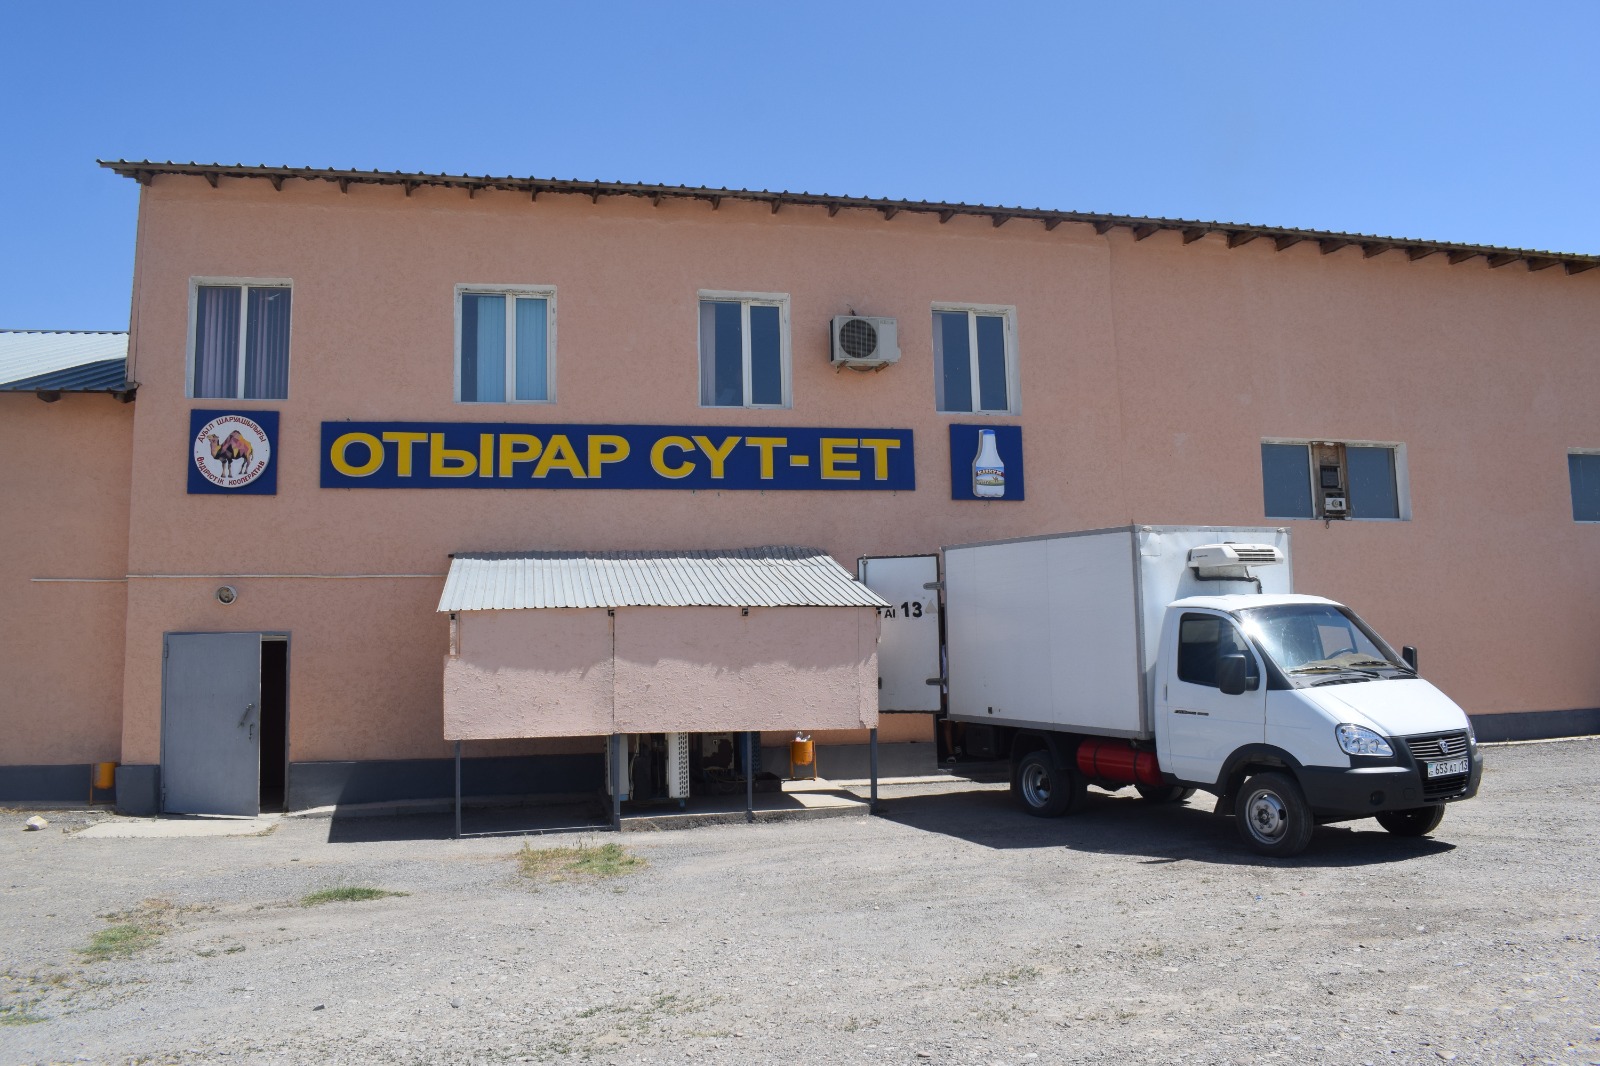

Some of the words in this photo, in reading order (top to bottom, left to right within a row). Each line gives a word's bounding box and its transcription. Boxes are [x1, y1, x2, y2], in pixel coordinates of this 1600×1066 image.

[198, 423, 214, 443] АУЫЛ
[330, 432, 631, 479] ОТЫРАР
[228, 460, 265, 486] КООПЕРАТИВ
[901, 601, 923, 618] 13
[1435, 762, 1448, 775] 653
[1460, 760, 1468, 771] 13
